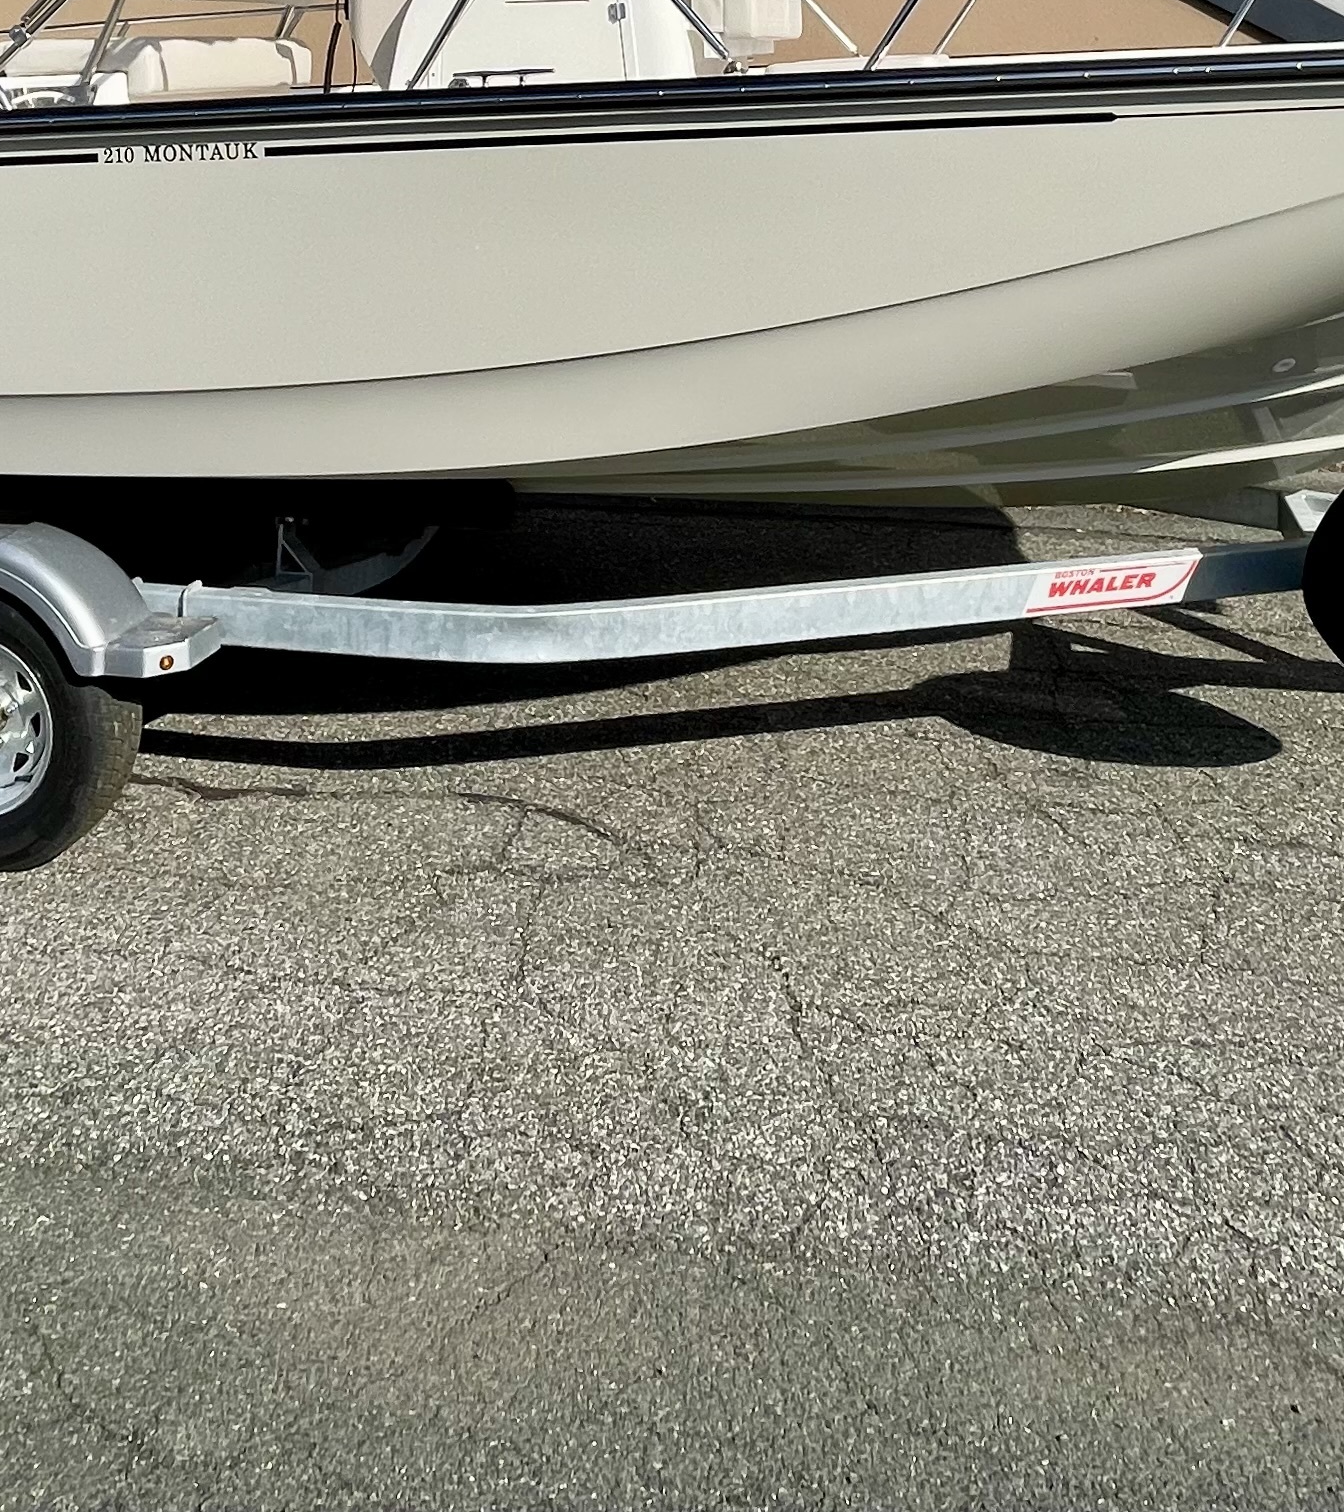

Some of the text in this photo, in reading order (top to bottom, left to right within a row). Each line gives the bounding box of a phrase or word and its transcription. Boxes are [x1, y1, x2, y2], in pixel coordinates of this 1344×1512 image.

[103, 141, 259, 164] 210 MONTAUK
[1048, 572, 1157, 598] WHALER
